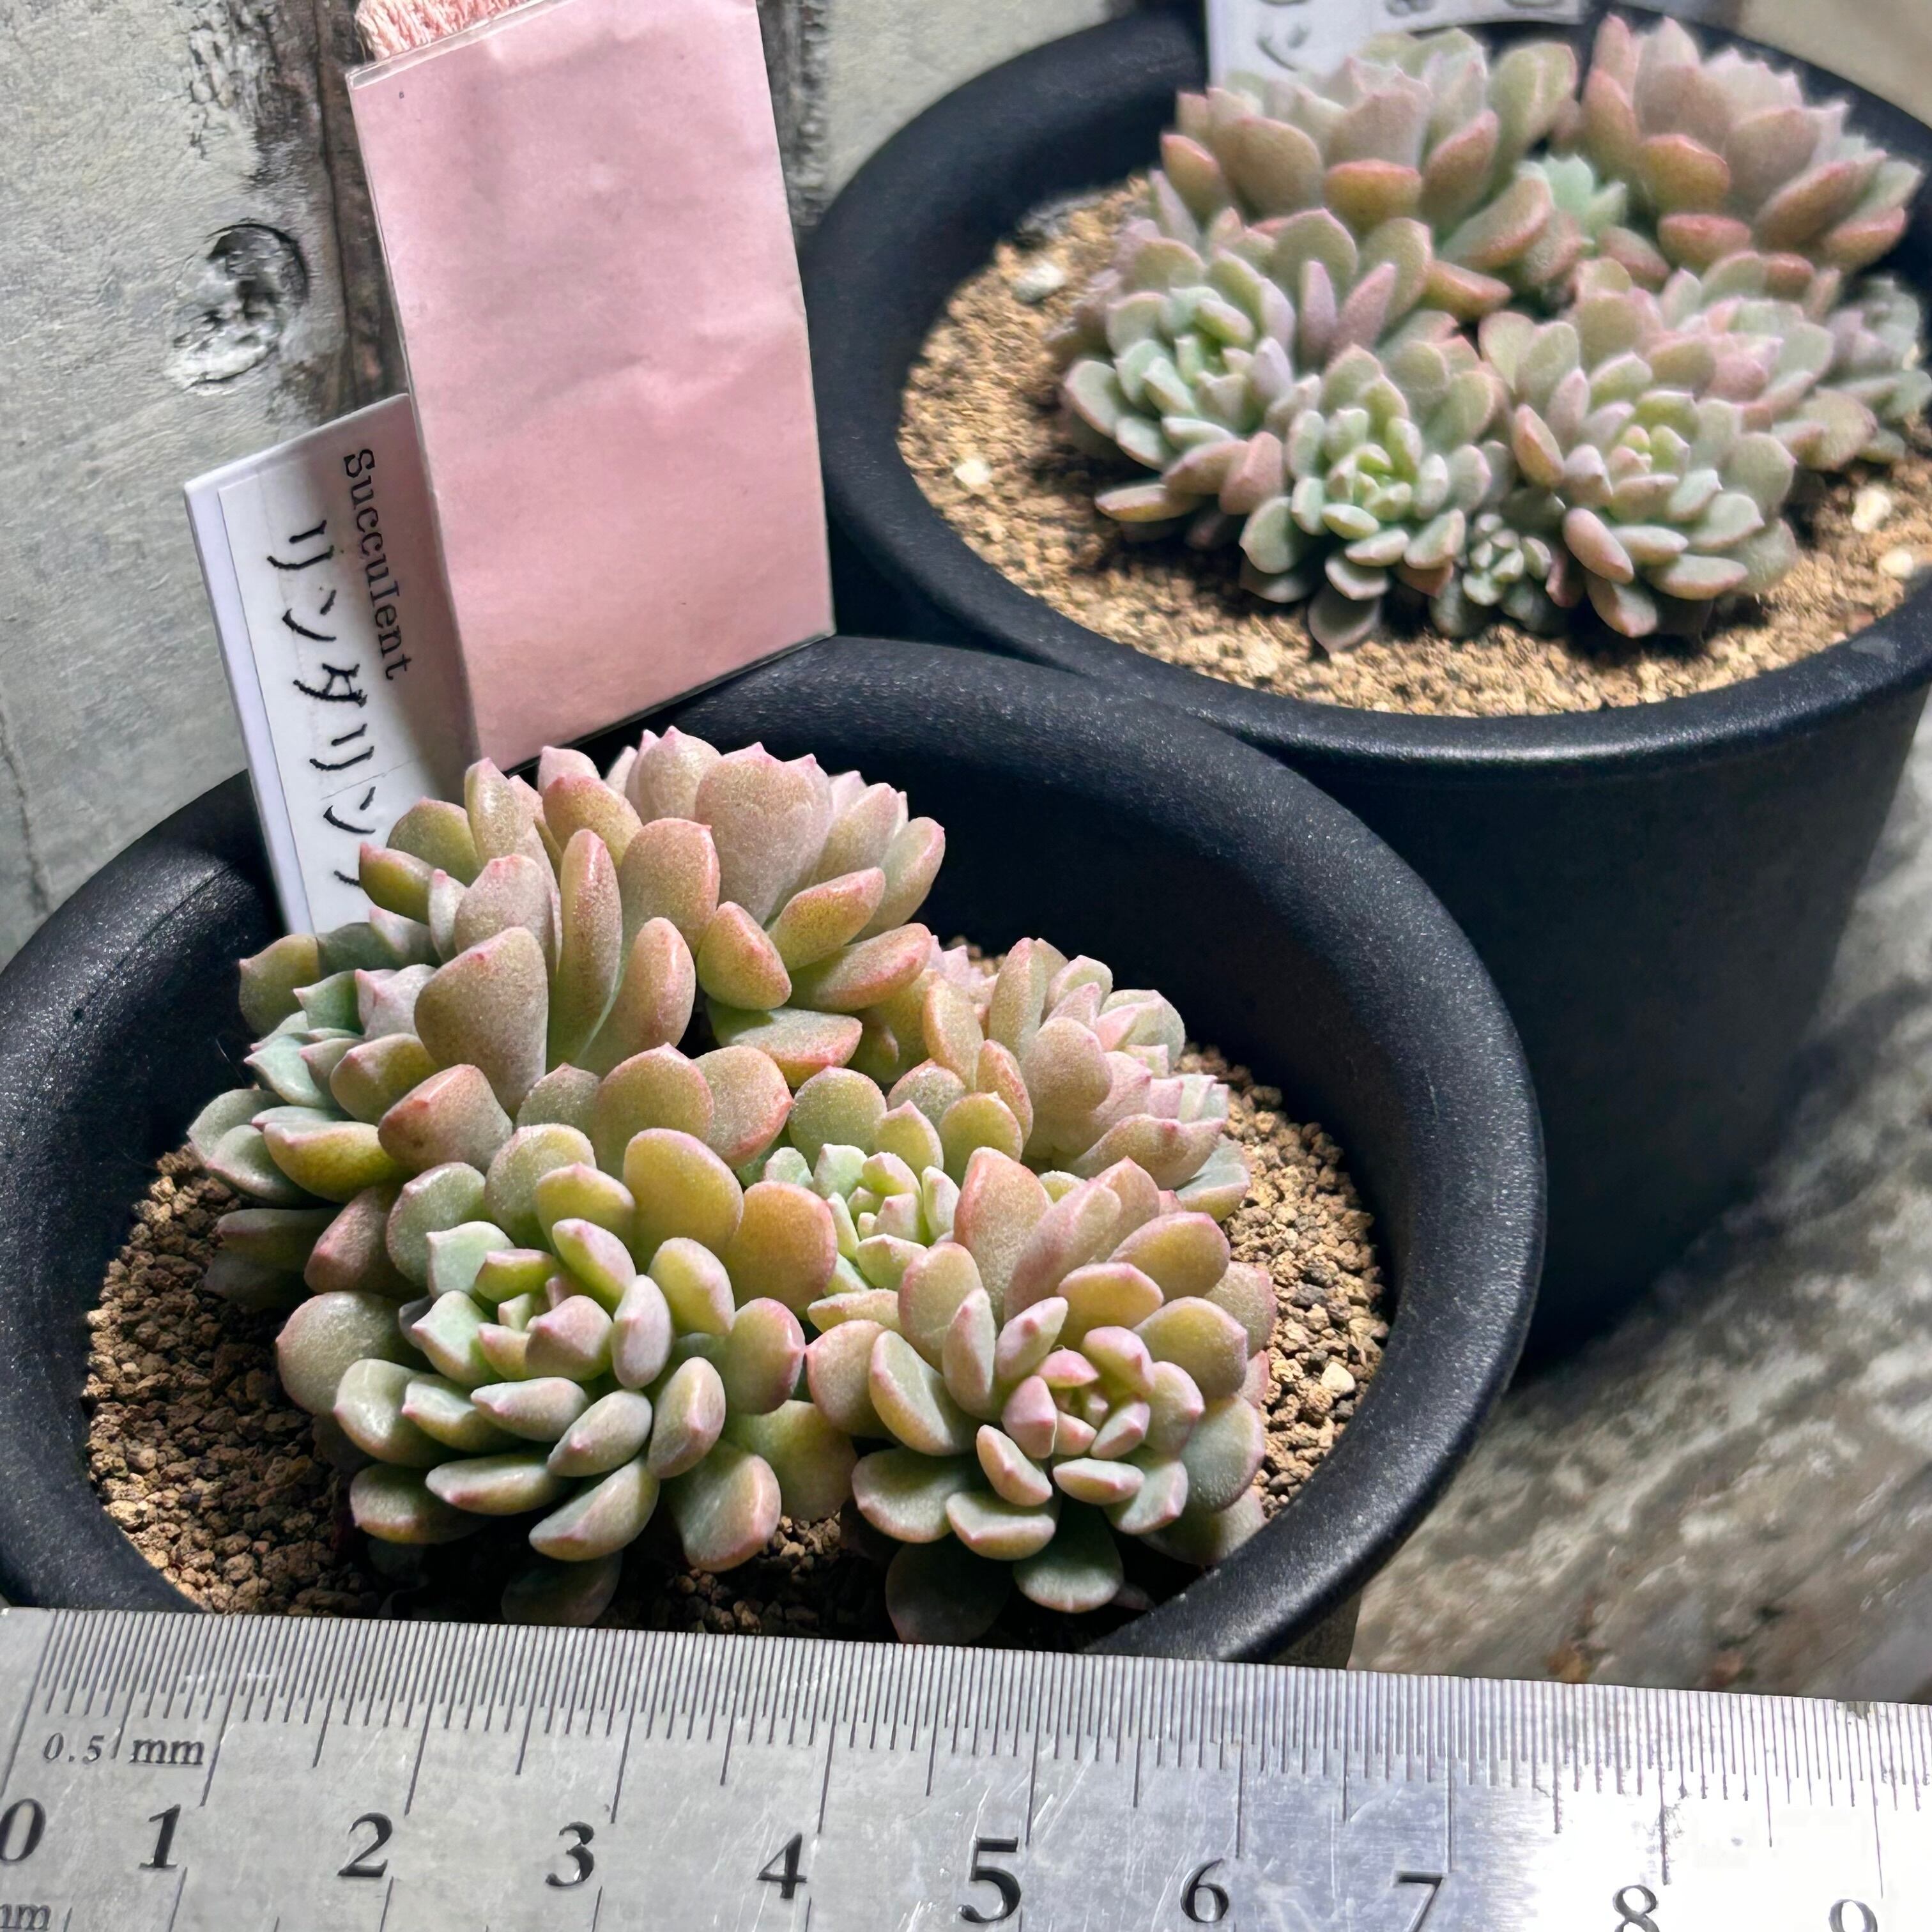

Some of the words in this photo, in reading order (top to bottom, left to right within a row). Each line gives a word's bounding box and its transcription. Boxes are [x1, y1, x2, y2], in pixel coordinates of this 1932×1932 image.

[344, 448, 411, 680] Succulent
[267, 519, 377, 887] リンダリン
[43, 1732, 104, 1763] 0.5
[130, 1737, 204, 1765] mm
[0, 1798, 45, 1863] 0
[139, 1804, 181, 1869] 1
[337, 1812, 392, 1877] 2
[546, 1821, 595, 1886] 3
[756, 1832, 808, 1899] 4
[959, 1837, 1022, 1923] 5
[1180, 1858, 1229, 1922] 6
[1393, 1871, 1444, 1932] 7
